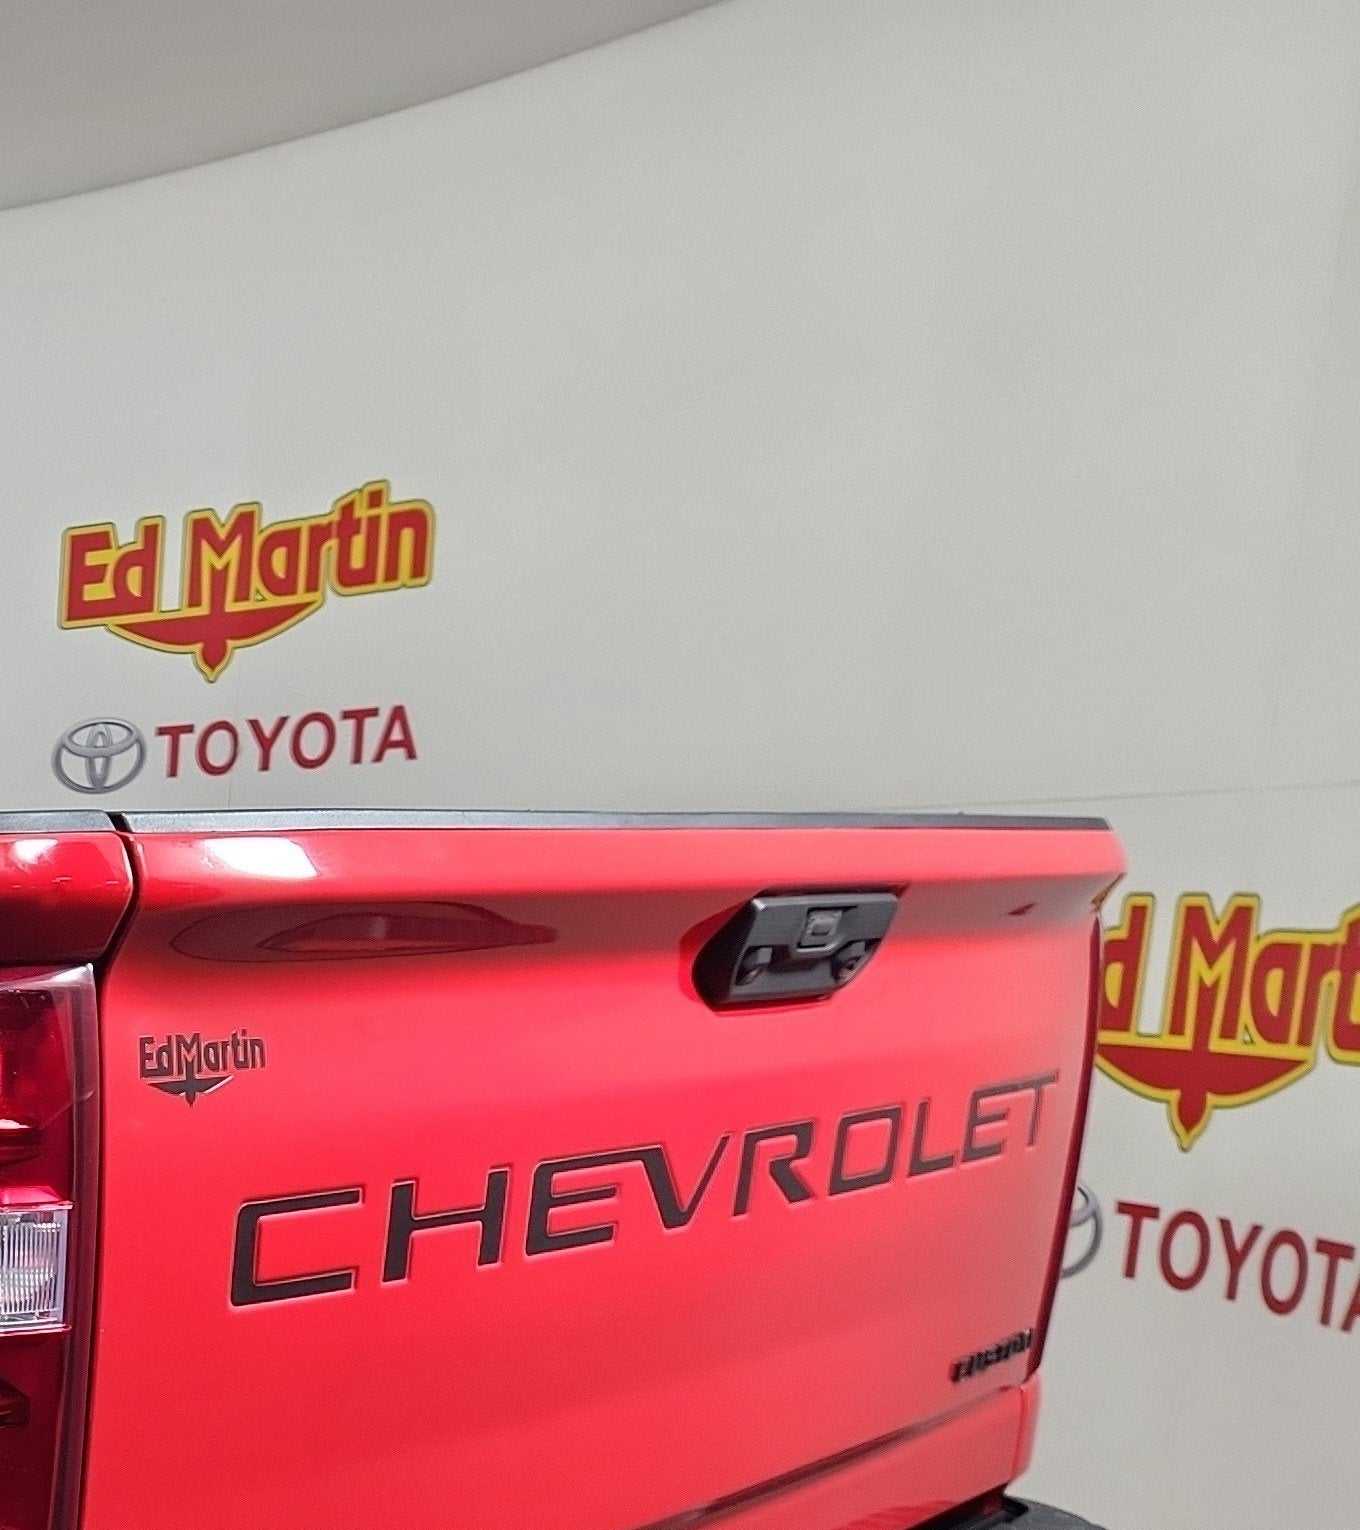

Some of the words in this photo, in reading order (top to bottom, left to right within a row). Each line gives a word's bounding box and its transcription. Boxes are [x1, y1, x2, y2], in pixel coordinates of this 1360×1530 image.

[59, 516, 167, 629] Ed
[183, 480, 437, 612] Martin
[154, 704, 418, 778] TOYOTA
[1100, 893, 1154, 1037] d
[231, 1070, 1059, 1306] CHEVROLET
